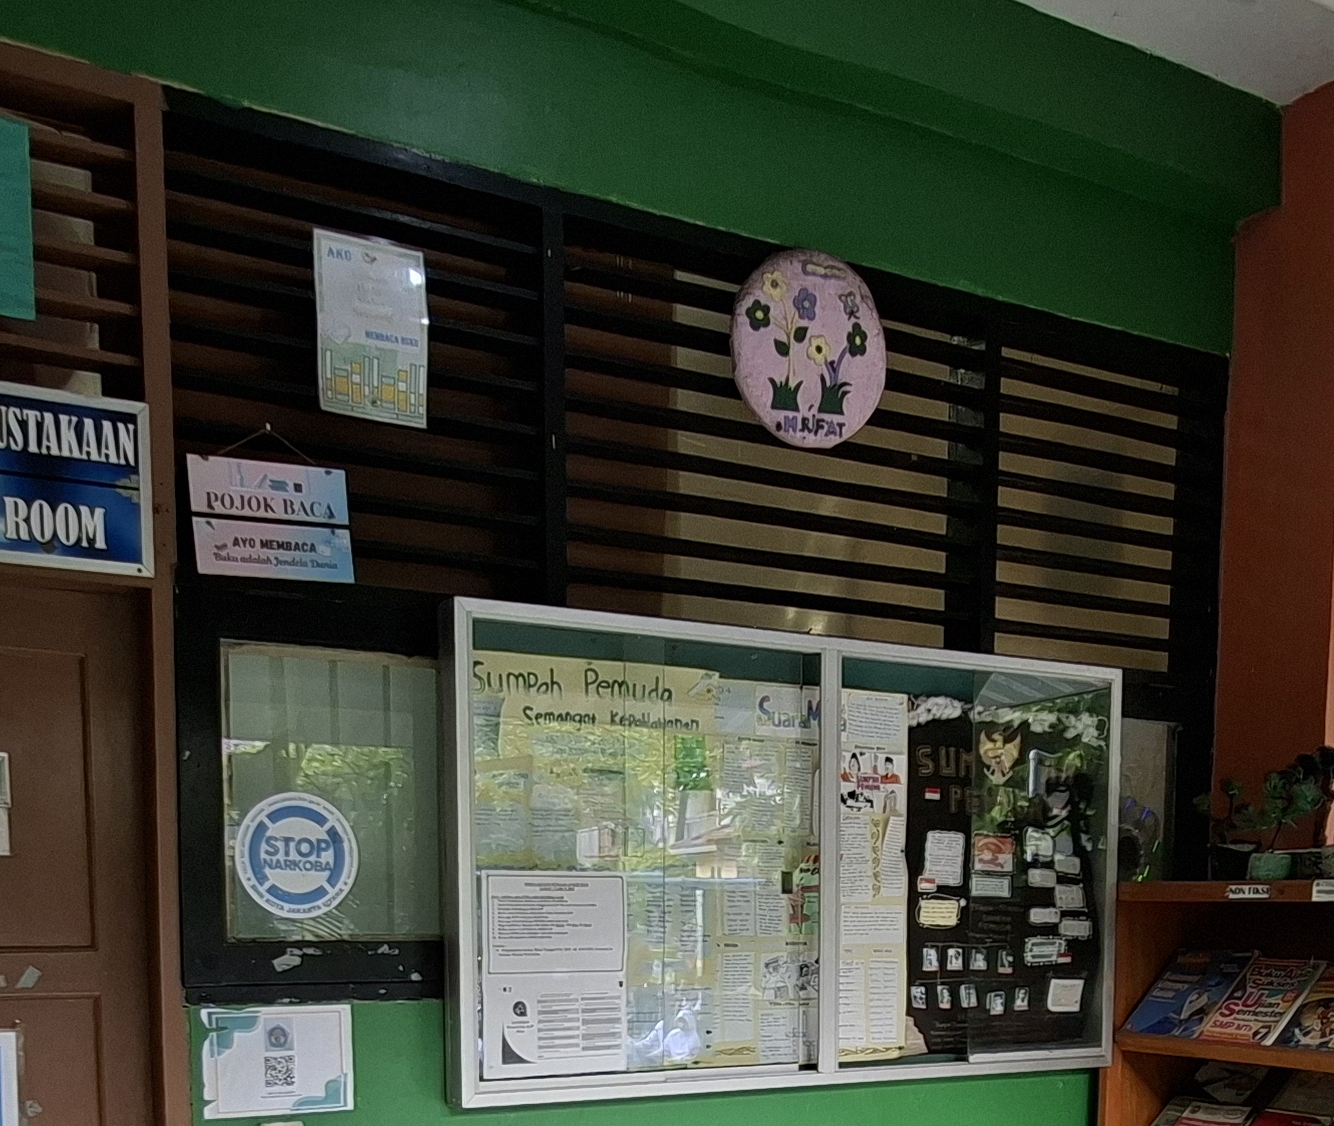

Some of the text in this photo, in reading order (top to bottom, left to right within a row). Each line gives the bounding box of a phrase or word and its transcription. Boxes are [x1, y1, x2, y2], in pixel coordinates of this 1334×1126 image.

[206, 491, 336, 520] POJOK BACA
[3, 496, 107, 550] ROOM
[232, 536, 317, 553] AYO MEMBACA
[473, 661, 563, 700] Sumpah
[584, 667, 673, 703] Pemuda
[264, 836, 331, 858] STOP
[263, 858, 333, 872] NARKOBA
